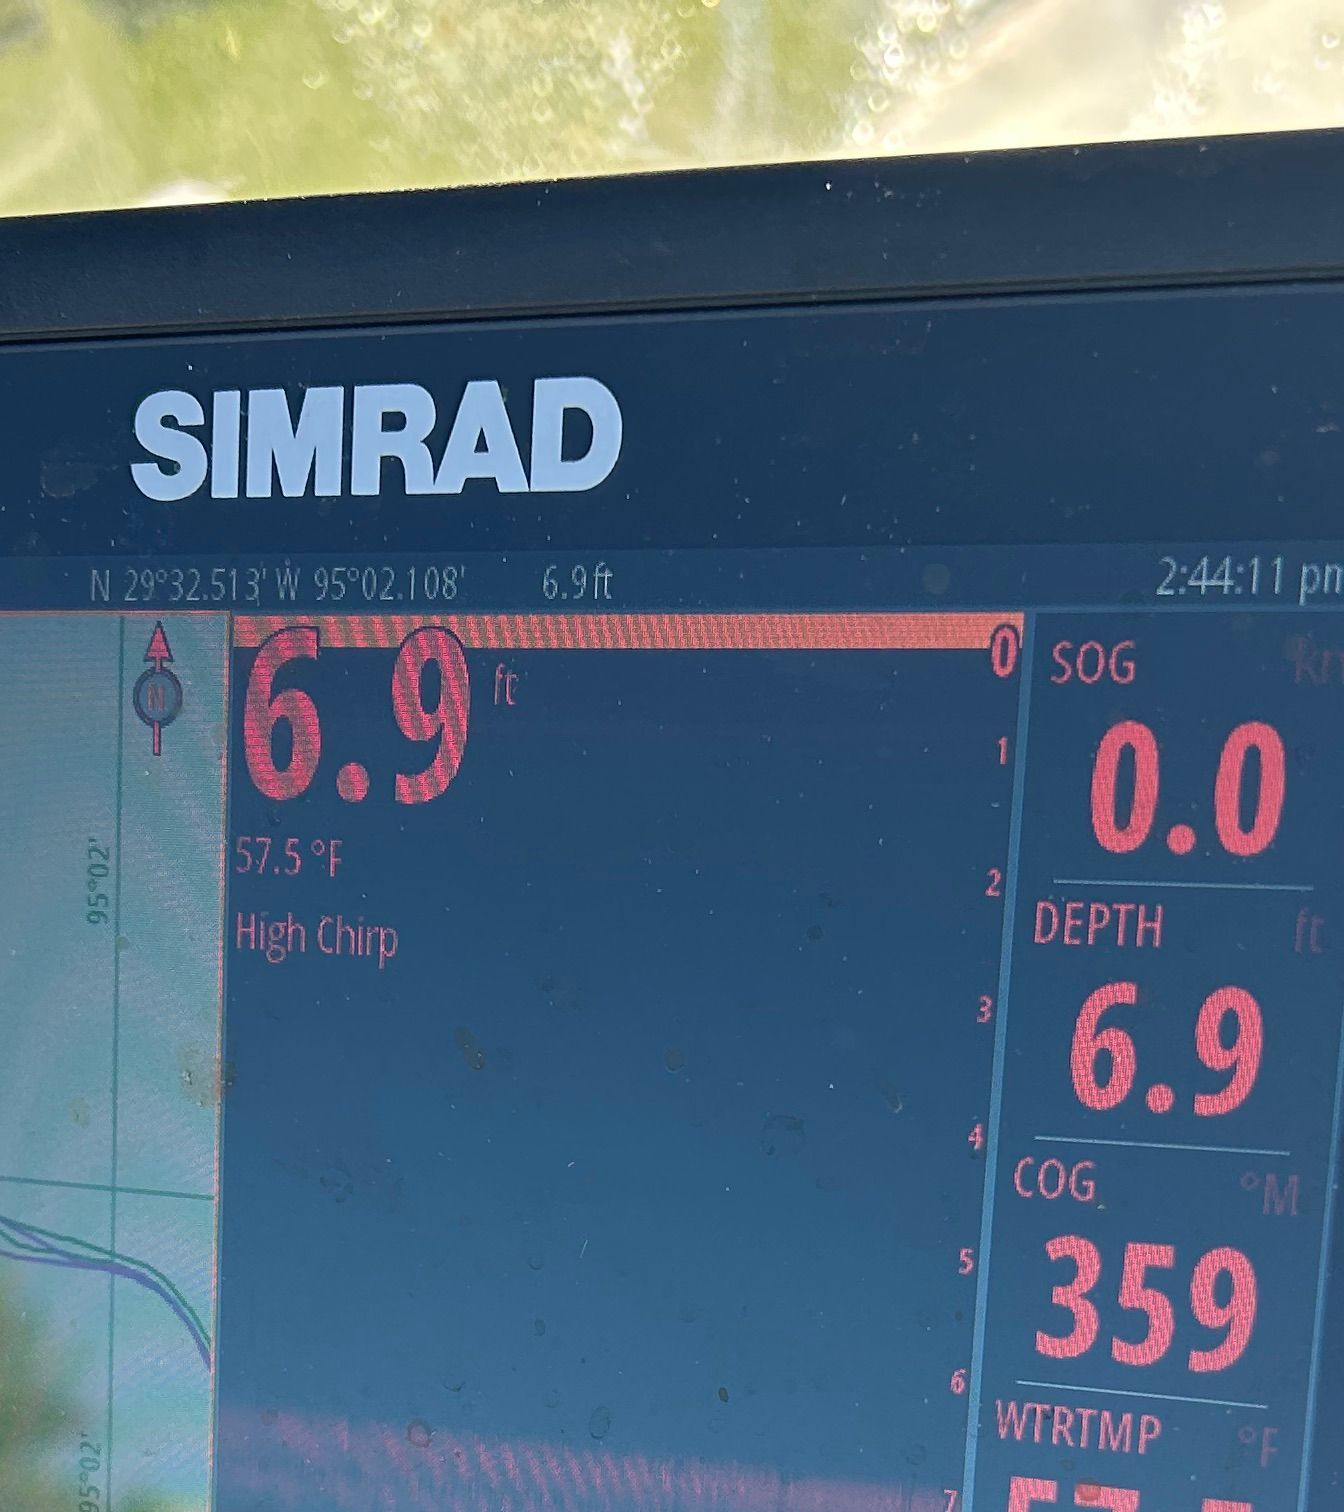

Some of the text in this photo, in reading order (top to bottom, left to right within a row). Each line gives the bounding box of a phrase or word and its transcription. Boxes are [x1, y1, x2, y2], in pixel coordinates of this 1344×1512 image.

[130, 376, 623, 502] SIMRAD
[90, 570, 110, 601] N
[276, 565, 301, 600] W
[1156, 555, 1284, 598] 2:44:11
[991, 622, 1018, 678] 0
[1050, 639, 1137, 685] SOG
[243, 624, 518, 805] 6.9 ft
[998, 736, 1009, 766] 1
[1091, 720, 1286, 856] 0.0
[235, 835, 344, 878] 57.5 °F
[985, 868, 1002, 898] 2
[235, 911, 399, 968] High Chirp
[1033, 901, 1165, 949] DEPTH
[977, 997, 993, 1025] 3
[1069, 982, 1264, 1118] 6.9
[968, 1123, 984, 1151] 4
[1014, 1156, 1096, 1202] COG
[959, 1247, 974, 1276] 5
[1034, 1234, 1258, 1373] 359
[949, 1368, 967, 1394] 6
[996, 1399, 1163, 1454] WTRTMP
